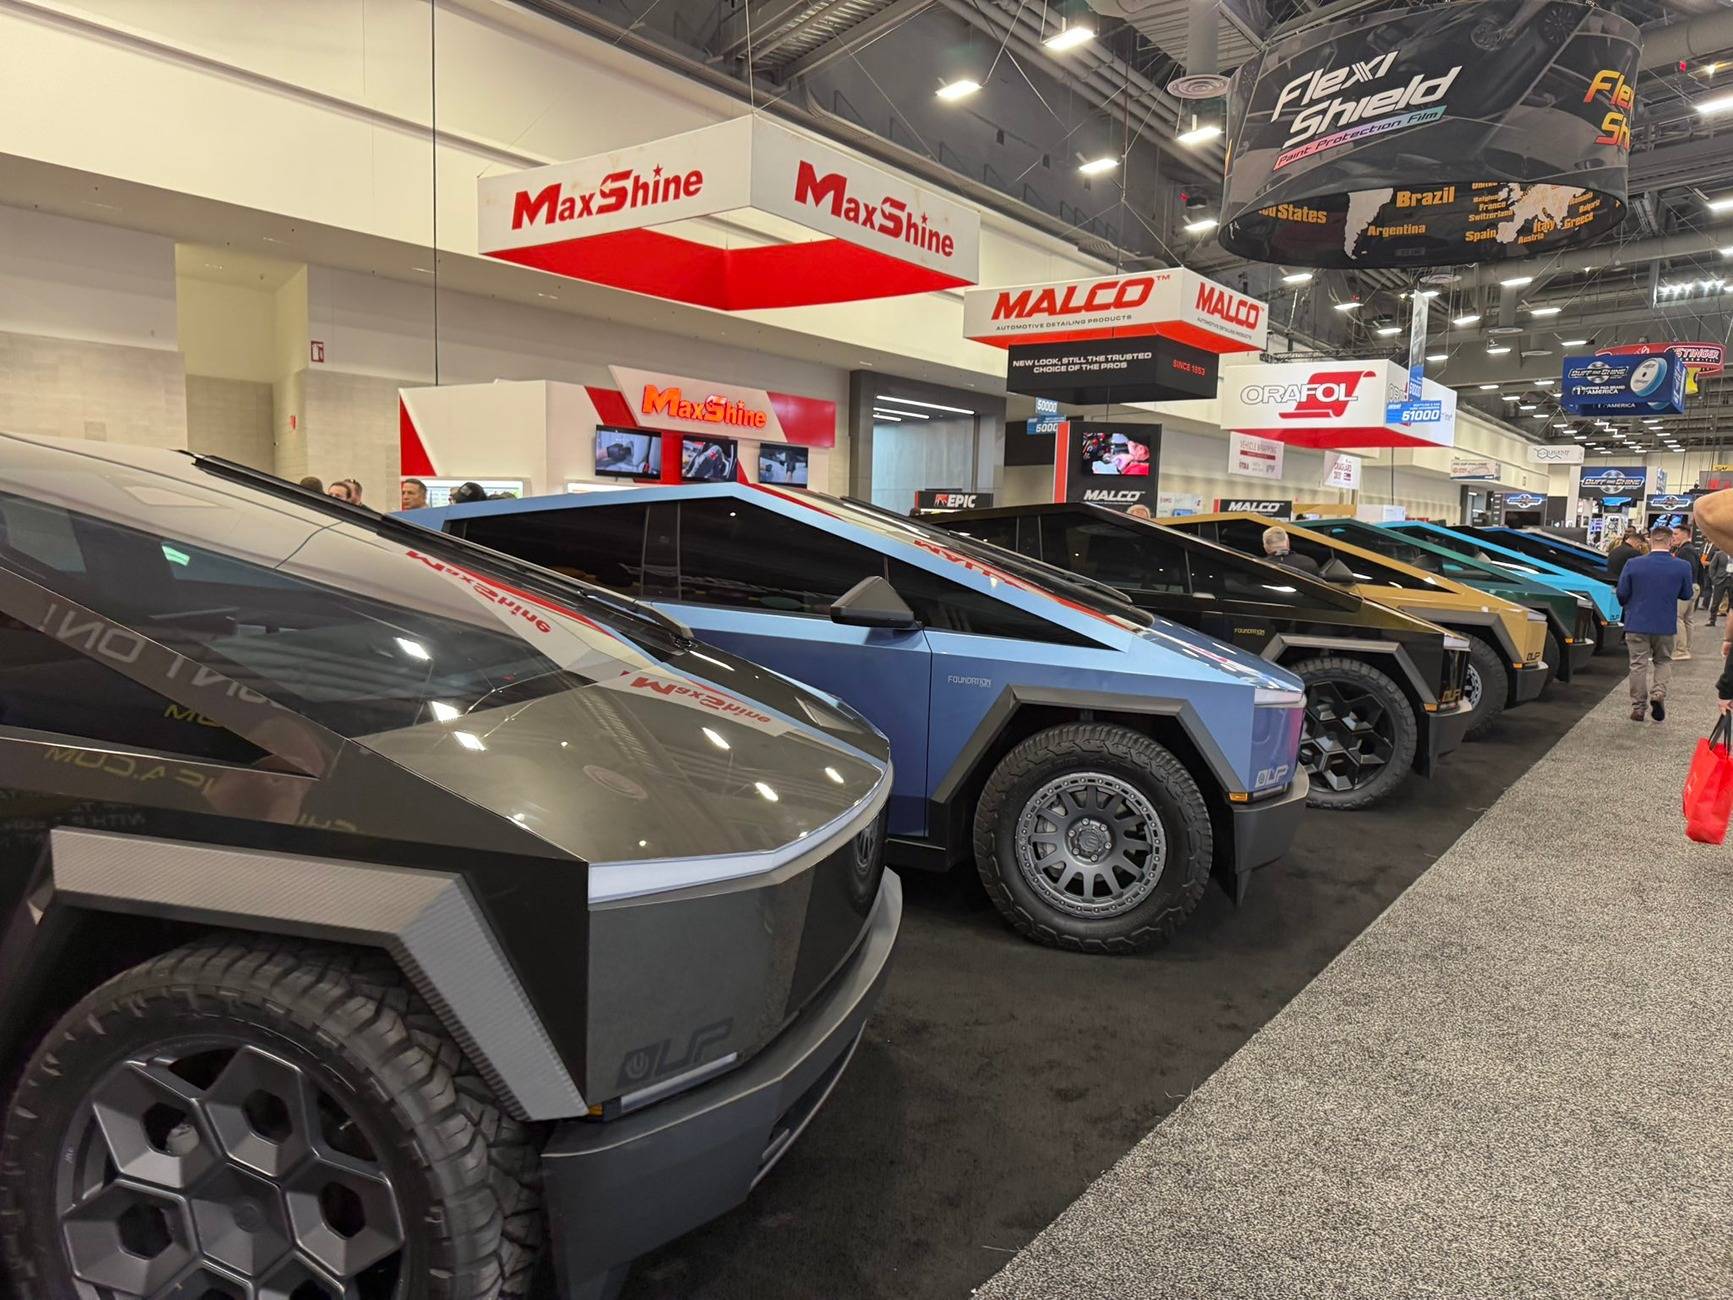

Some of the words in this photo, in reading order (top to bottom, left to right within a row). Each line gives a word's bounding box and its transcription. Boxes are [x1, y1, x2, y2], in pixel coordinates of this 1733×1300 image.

[1271, 51, 1399, 123] Flexi
[1583, 69, 1633, 109] Fle
[1282, 66, 1462, 149] Shield
[1278, 146, 1311, 167] Paint
[1315, 120, 1400, 150] Protection
[1407, 111, 1438, 124] Film
[510, 163, 704, 231] MaxShine
[1396, 185, 1456, 208] Brazil
[794, 160, 955, 258] MaxShine
[1277, 203, 1327, 224] States
[1468, 209, 1514, 222] Switzerland
[1367, 223, 1426, 238] Argentina
[1465, 228, 1497, 242] Spain
[1533, 219, 1557, 233] Italy
[991, 276, 1155, 320] MALCO
[1195, 281, 1260, 330] MALCO
[996, 322, 1044, 331] AUTOMOTIVE
[1045, 319, 1085, 328] DETAILING
[1087, 314, 1132, 324] PRODUCTS
[1013, 358, 1034, 367] NEW
[1035, 357, 1061, 367] LOOK,
[1062, 355, 1086, 364] STILL
[1087, 354, 1106, 362] THE
[1107, 352, 1152, 361] TRUSTED
[1033, 365, 1066, 373] CHOICE
[1068, 364, 1080, 372] OF
[1081, 362, 1100, 371] THE
[1101, 361, 1127, 370] PROS
[1240, 382, 1359, 406] ORAFOL
[641, 383, 768, 429] MaxShine
[1035, 423, 1058, 433] 5000
[947, 494, 978, 508] EPIC
[1083, 489, 1140, 501] MALCO
[1228, 501, 1281, 512] MALCO
